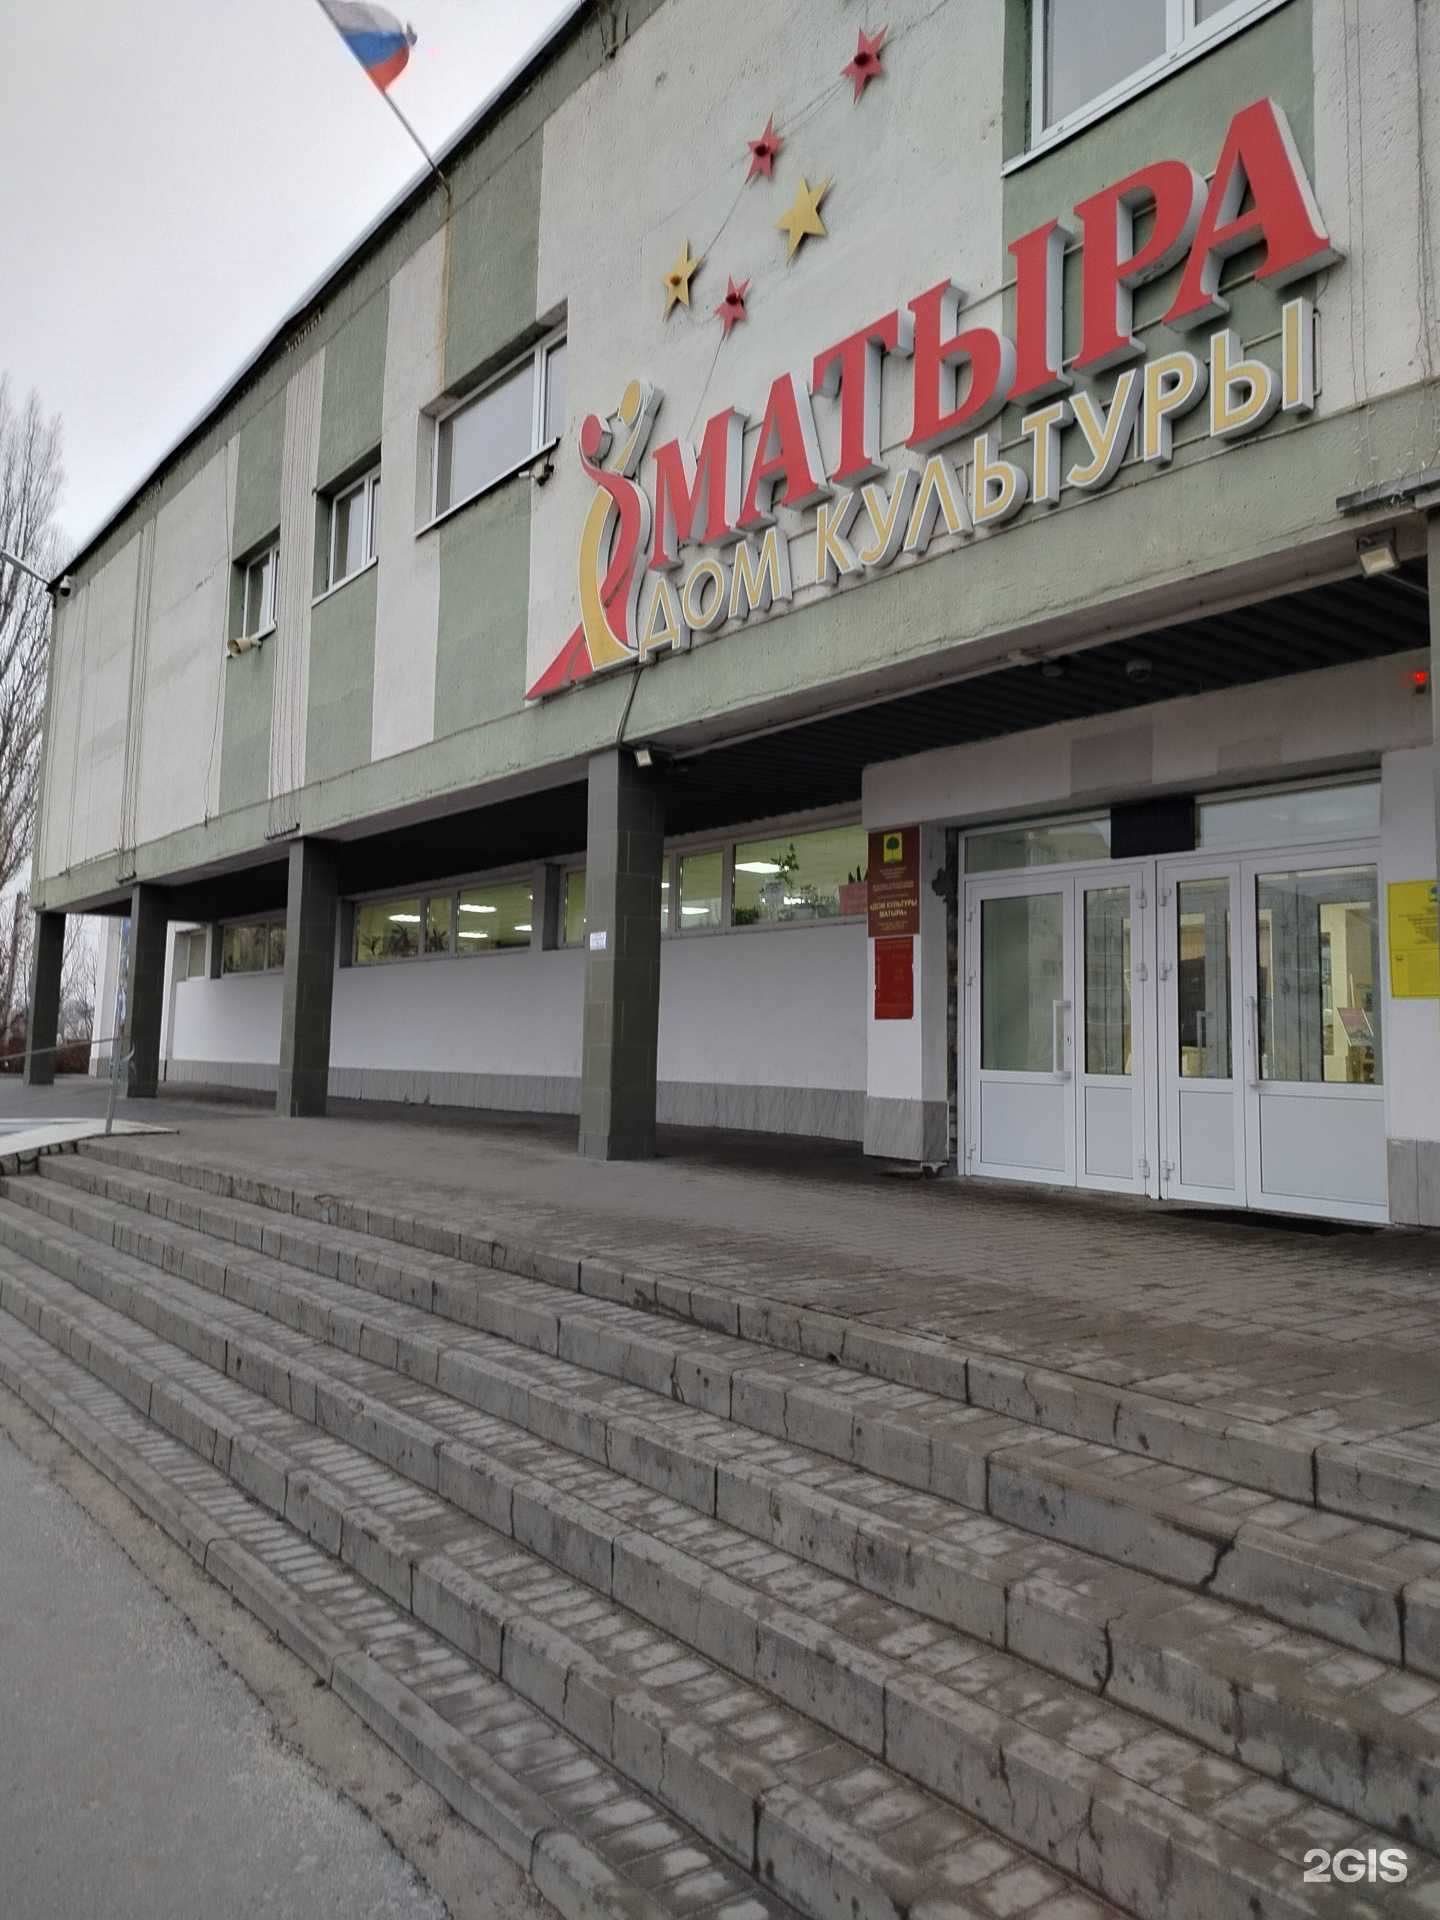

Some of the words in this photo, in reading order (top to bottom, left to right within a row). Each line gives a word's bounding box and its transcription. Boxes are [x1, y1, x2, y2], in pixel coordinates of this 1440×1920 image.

[639, 527, 790, 662] ДОМ
[816, 298, 1311, 585] КУЛЬТУРЫ
[648, 97, 1335, 572] МАТЫРА
